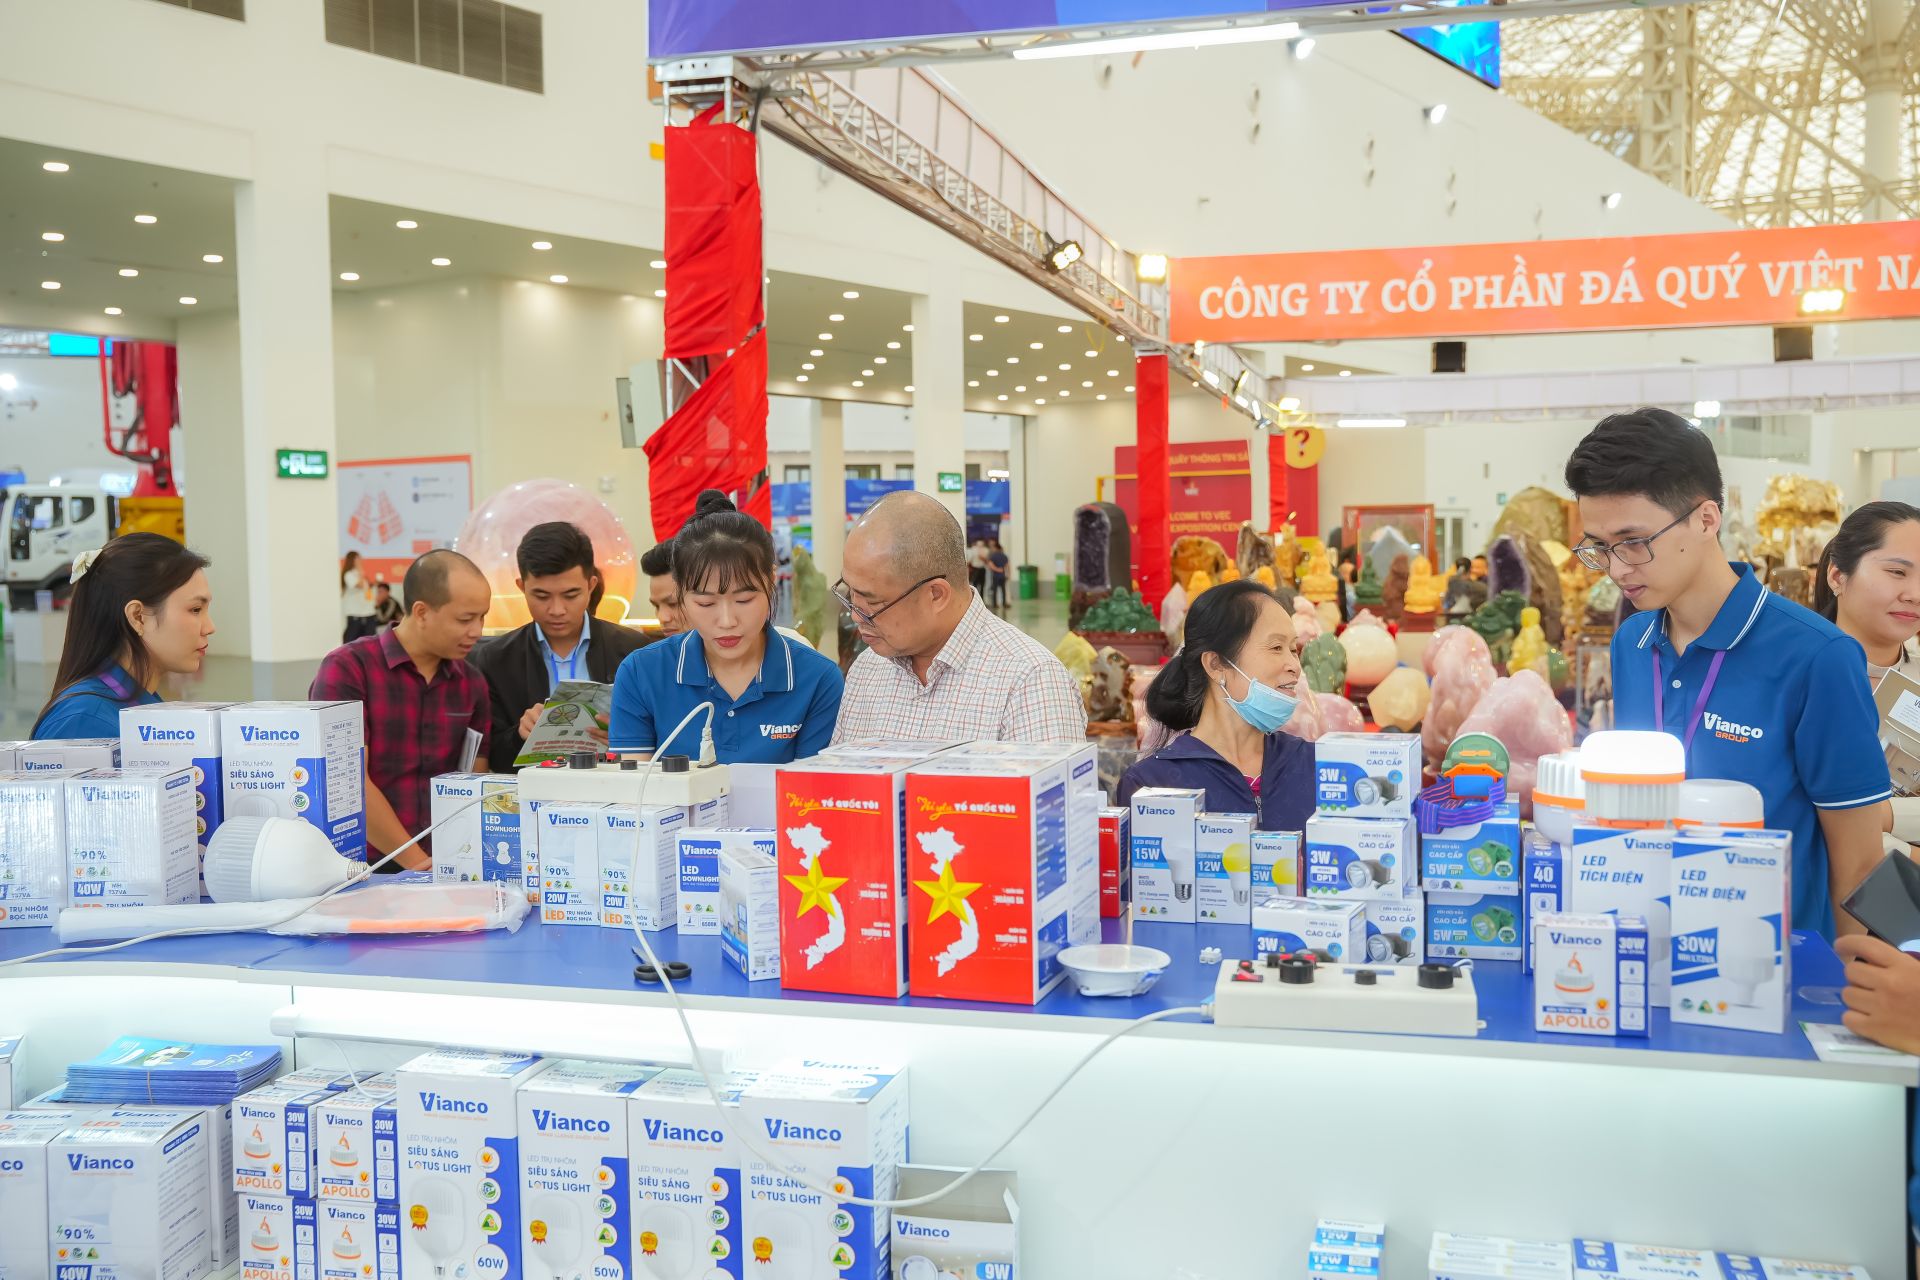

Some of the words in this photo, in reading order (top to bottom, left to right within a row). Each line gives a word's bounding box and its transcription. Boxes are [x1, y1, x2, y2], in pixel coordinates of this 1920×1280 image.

[1199, 275, 1309, 320] CÔNG
[1319, 280, 1370, 315] TY
[1381, 258, 1437, 313] CỔ
[1448, 254, 1566, 311] PHẦN
[1579, 256, 1644, 305] ĐÁ
[1656, 251, 1747, 308] QUÝ
[1200, 512, 1213, 520] TO
[1214, 511, 1231, 520] VEC
[1703, 711, 1763, 739] Vianco
[138, 725, 195, 742] Vianco
[240, 725, 300, 742] Vianco
[1715, 730, 1749, 744] GROUP
[24, 761, 63, 771] Vianco
[1386, 756, 1403, 766] CẤP
[230, 769, 248, 779] SIÊU
[250, 768, 274, 779] SÁNG
[1319, 768, 1340, 782] 3W
[230, 781, 258, 791] LOTUS
[260, 781, 285, 790] LIGHT
[436, 784, 473, 796] Vianco
[0, 788, 46, 801] ianco
[82, 786, 140, 801] Vianco
[1326, 791, 1342, 799] DP1
[835, 797, 862, 809] QUỐC
[862, 799, 879, 810] TÔI
[969, 801, 997, 813] QUỐC
[998, 803, 1016, 814] TÔI
[1137, 805, 1176, 816] Vianco
[485, 815, 501, 825] LED
[548, 813, 589, 825] Vianco
[1200, 824, 1234, 834] Vianco
[682, 844, 719, 856] Vianco
[1255, 843, 1282, 851] Vianco
[1358, 842, 1376, 850] CAO
[1378, 840, 1395, 849] CẤP
[1624, 838, 1673, 850] Vianco
[80, 850, 107, 860] 90%
[1134, 847, 1160, 861] 15W
[1310, 850, 1331, 864] 3W
[1429, 851, 1446, 859] CAO
[1447, 850, 1463, 859] CẤP
[1724, 852, 1777, 867] Vianco
[1198, 861, 1221, 872] 12W
[1582, 855, 1607, 866] LED
[439, 866, 455, 875] 12W
[549, 867, 570, 876] 90%
[607, 870, 627, 880] 90%
[682, 865, 699, 875] LED
[1429, 864, 1447, 875] 5W
[1533, 866, 1554, 882] 40
[1681, 869, 1707, 881] LED
[1252, 871, 1270, 882] 5W
[1317, 874, 1333, 882] DP1
[1580, 869, 1608, 882] TÍCH
[1612, 871, 1645, 886] ĐIỆN
[77, 882, 101, 895] 40W
[1678, 883, 1708, 898] TÍCH
[1712, 887, 1746, 903] ĐIỆN
[546, 893, 566, 904] 20W
[605, 896, 623, 907] 20W
[25, 904, 48, 913] NHÔM
[545, 909, 565, 921] LED
[604, 913, 622, 924] LED
[1379, 915, 1397, 923] CAO
[1399, 914, 1416, 923] CẤP
[1434, 917, 1450, 925] CAO
[1451, 916, 1467, 925] CẤP
[1325, 928, 1342, 939] CẤP
[1434, 930, 1451, 941] 5W
[1550, 932, 1602, 946] Vianco
[1257, 936, 1278, 951] 3W
[1618, 937, 1646, 950] 30W
[1678, 935, 1715, 953] 30W
[1543, 1014, 1610, 1030] APOLLO
[419, 1092, 488, 1114] Vianco
[240, 1106, 276, 1119] Vianco
[287, 1111, 306, 1123] 30W
[326, 1114, 363, 1127] Vianco
[374, 1119, 394, 1131] 30W
[532, 1109, 611, 1133] Vianco
[643, 1118, 724, 1143] Vianco
[764, 1118, 842, 1142] Vianco
[407, 1145, 428, 1156] SIÊU
[431, 1146, 459, 1159] SÁNG
[67, 1153, 134, 1171] Vianco
[408, 1160, 439, 1171] LOTUS
[443, 1163, 472, 1174] LIGHT
[527, 1166, 547, 1177] SIÊU
[550, 1167, 578, 1179] SÁNG
[236, 1175, 282, 1190] APOLLO
[638, 1175, 658, 1187] SIÊU
[661, 1177, 690, 1189] SÁNG
[750, 1174, 773, 1186] SIÊU
[322, 1185, 370, 1199] APOLLO
[528, 1180, 558, 1190] LOTUS
[562, 1183, 591, 1193] LIGHT
[639, 1190, 670, 1201] LOTUS
[674, 1193, 704, 1204] LIGHT
[751, 1190, 786, 1201] LOTUS
[790, 1193, 822, 1205] LIGHT
[247, 1199, 283, 1212] Vianco
[294, 1205, 314, 1217] 30W
[327, 1207, 366, 1220] Vianco
[377, 1213, 397, 1225] 30W
[64, 1227, 95, 1239] 90%
[896, 1220, 950, 1238] Vianco
[1321, 1231, 1348, 1240] 12W
[477, 1256, 504, 1270] 60W
[1312, 1255, 1342, 1265] 12W
[60, 1266, 87, 1280] 40W
[594, 1267, 619, 1278] 50W
[984, 1263, 1009, 1280] 9W
